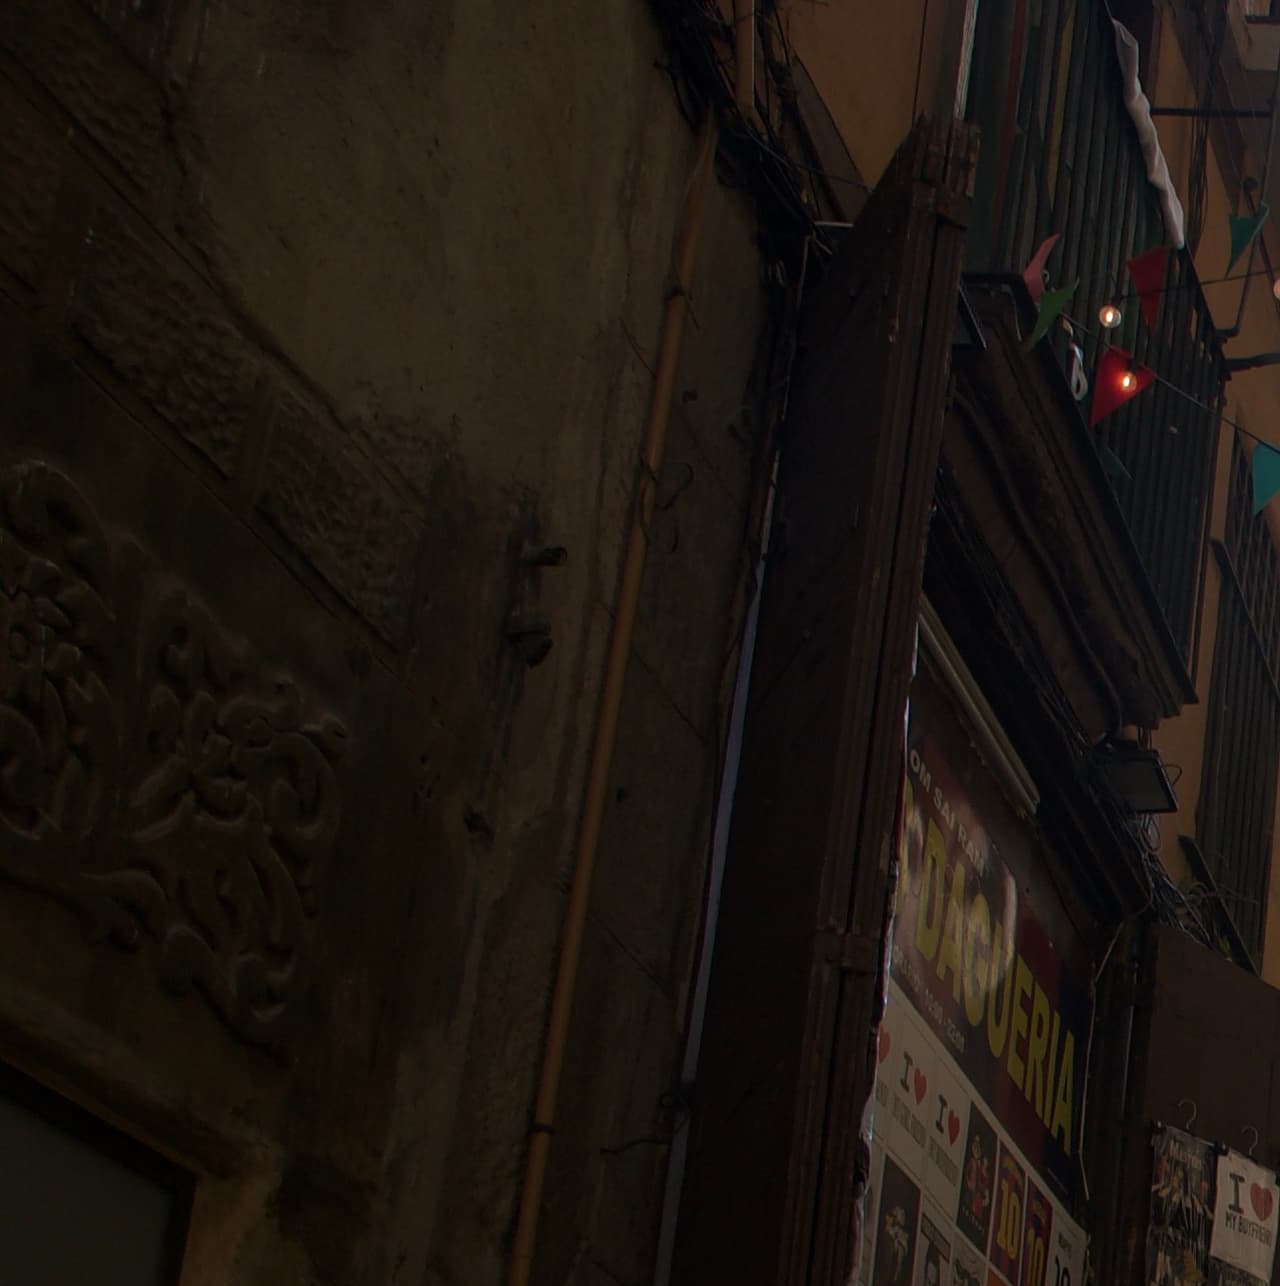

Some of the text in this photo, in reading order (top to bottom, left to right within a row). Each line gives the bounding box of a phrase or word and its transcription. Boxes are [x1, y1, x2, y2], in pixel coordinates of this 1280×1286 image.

[909, 750, 931, 793] OM
[1229, 1172, 1245, 1214] I
[996, 1178, 1021, 1260] 10
